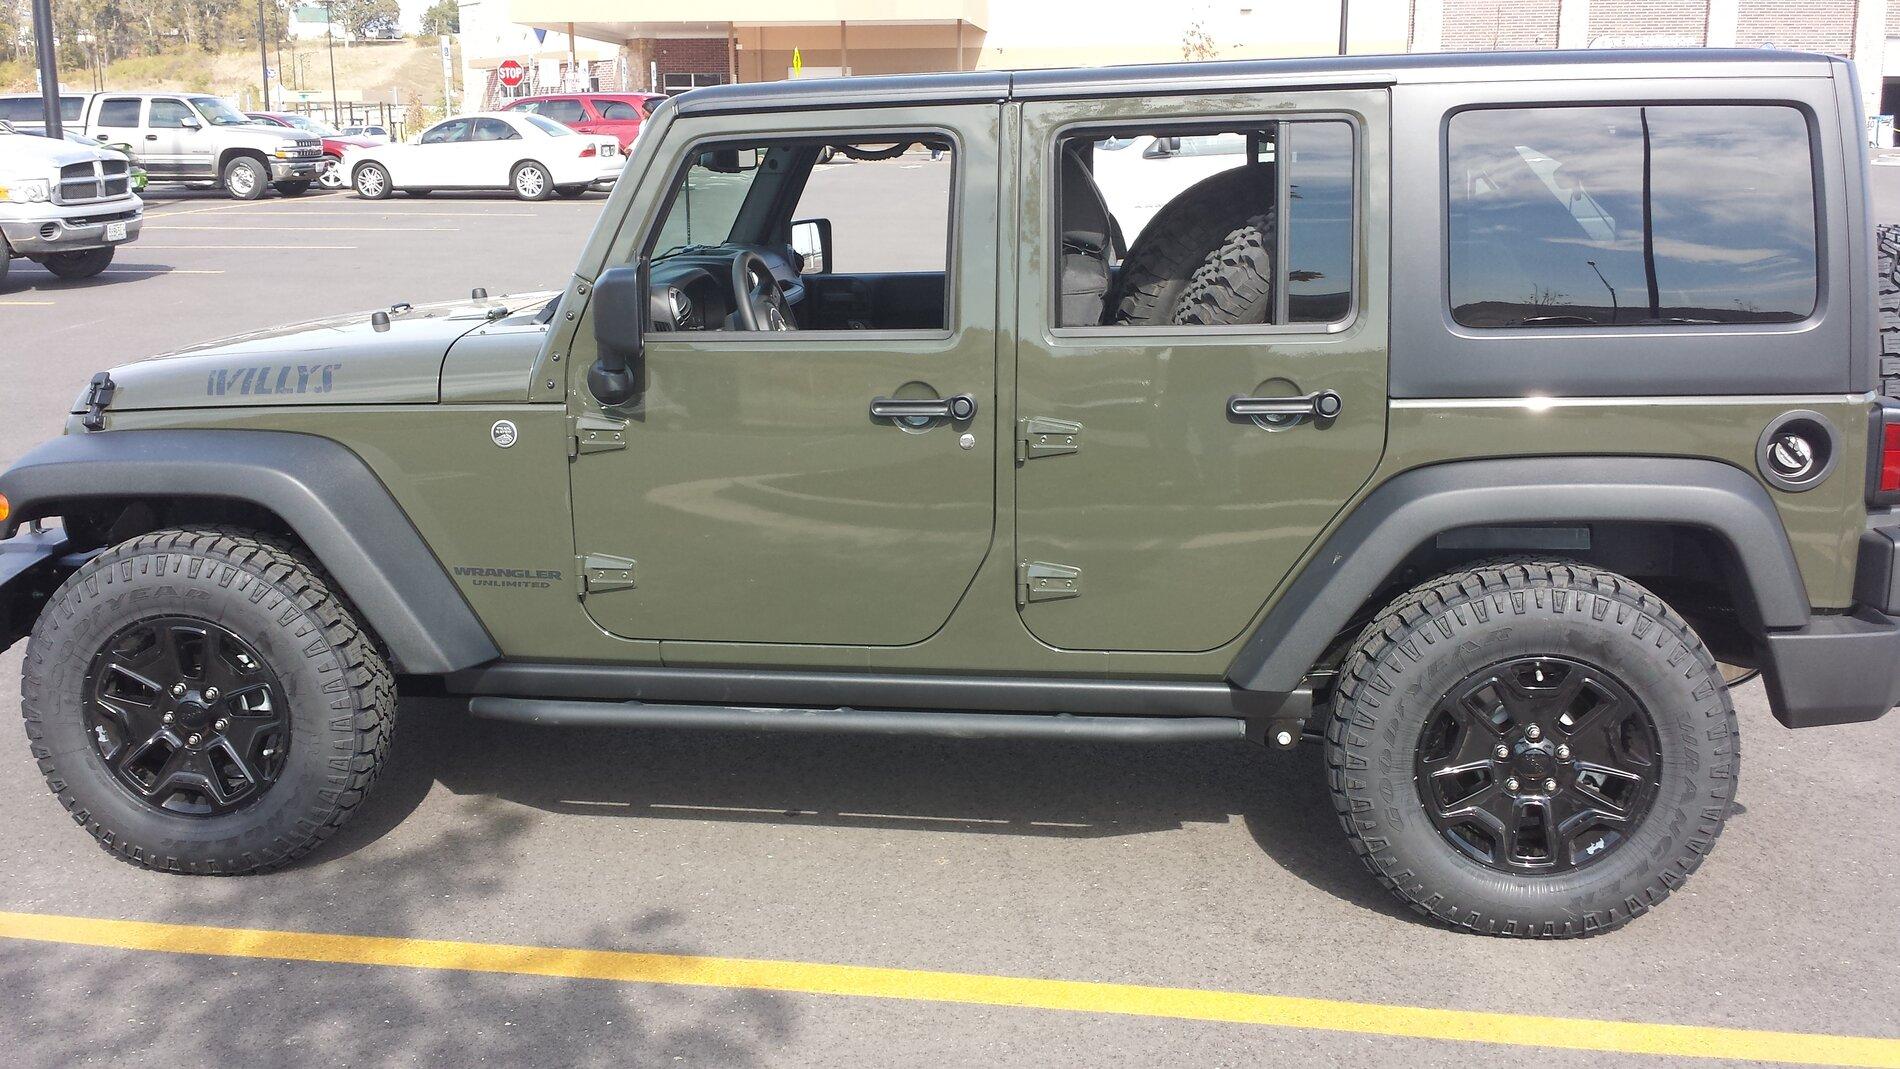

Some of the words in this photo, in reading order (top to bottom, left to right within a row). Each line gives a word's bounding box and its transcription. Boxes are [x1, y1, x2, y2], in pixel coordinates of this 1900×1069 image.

[499, 67, 522, 79] STOP
[207, 364, 342, 396] WILLYS
[453, 566, 564, 581] WRANGLER
[472, 579, 551, 589] UNLIMITED
